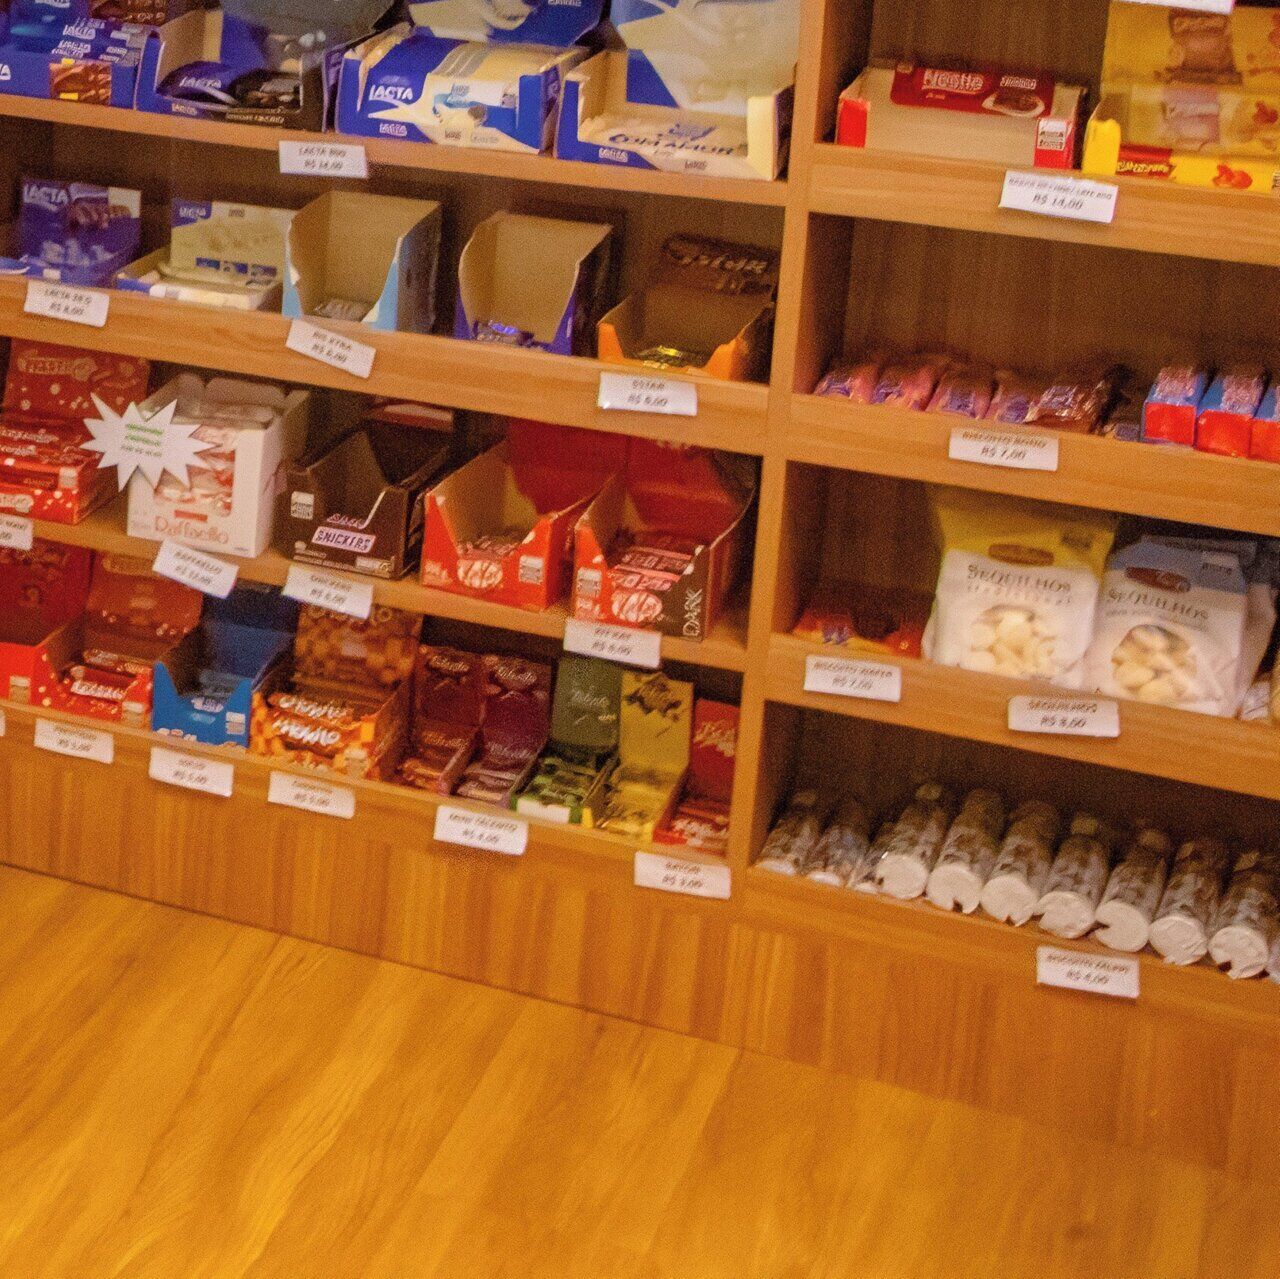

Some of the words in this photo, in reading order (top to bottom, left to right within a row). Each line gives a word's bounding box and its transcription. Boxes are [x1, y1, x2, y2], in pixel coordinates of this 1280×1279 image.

[369, 84, 414, 102] LACTA
[23, 183, 69, 206] LACTA
[1033, 194, 1049, 205] R$
